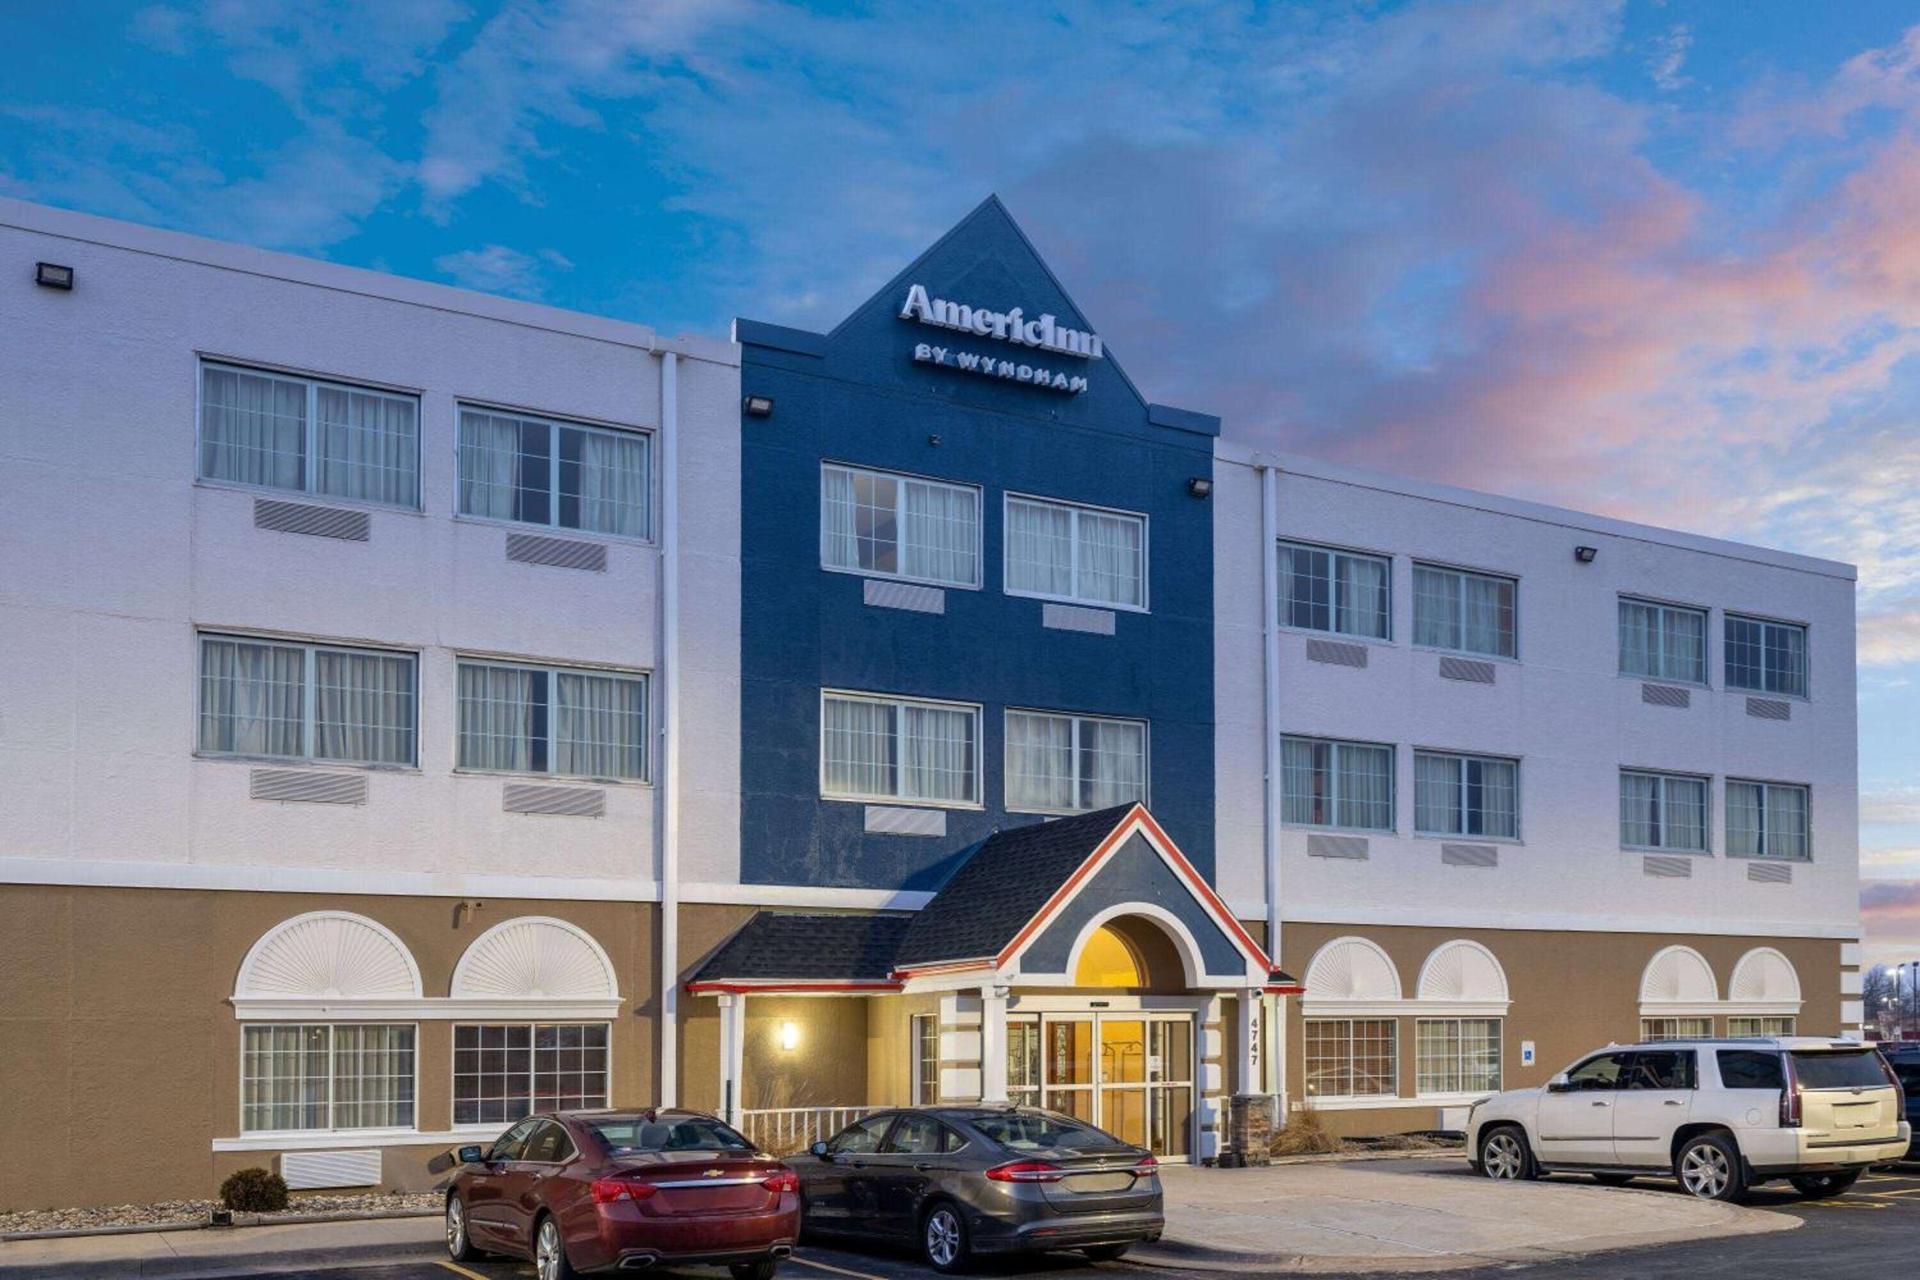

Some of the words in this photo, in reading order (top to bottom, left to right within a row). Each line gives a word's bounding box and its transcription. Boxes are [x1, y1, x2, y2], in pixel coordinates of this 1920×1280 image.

[899, 284, 1103, 359] AmericInn
[914, 343, 948, 364] BY
[956, 351, 1088, 394] WYNDHAM
[1250, 1018, 1258, 1066] 4747
